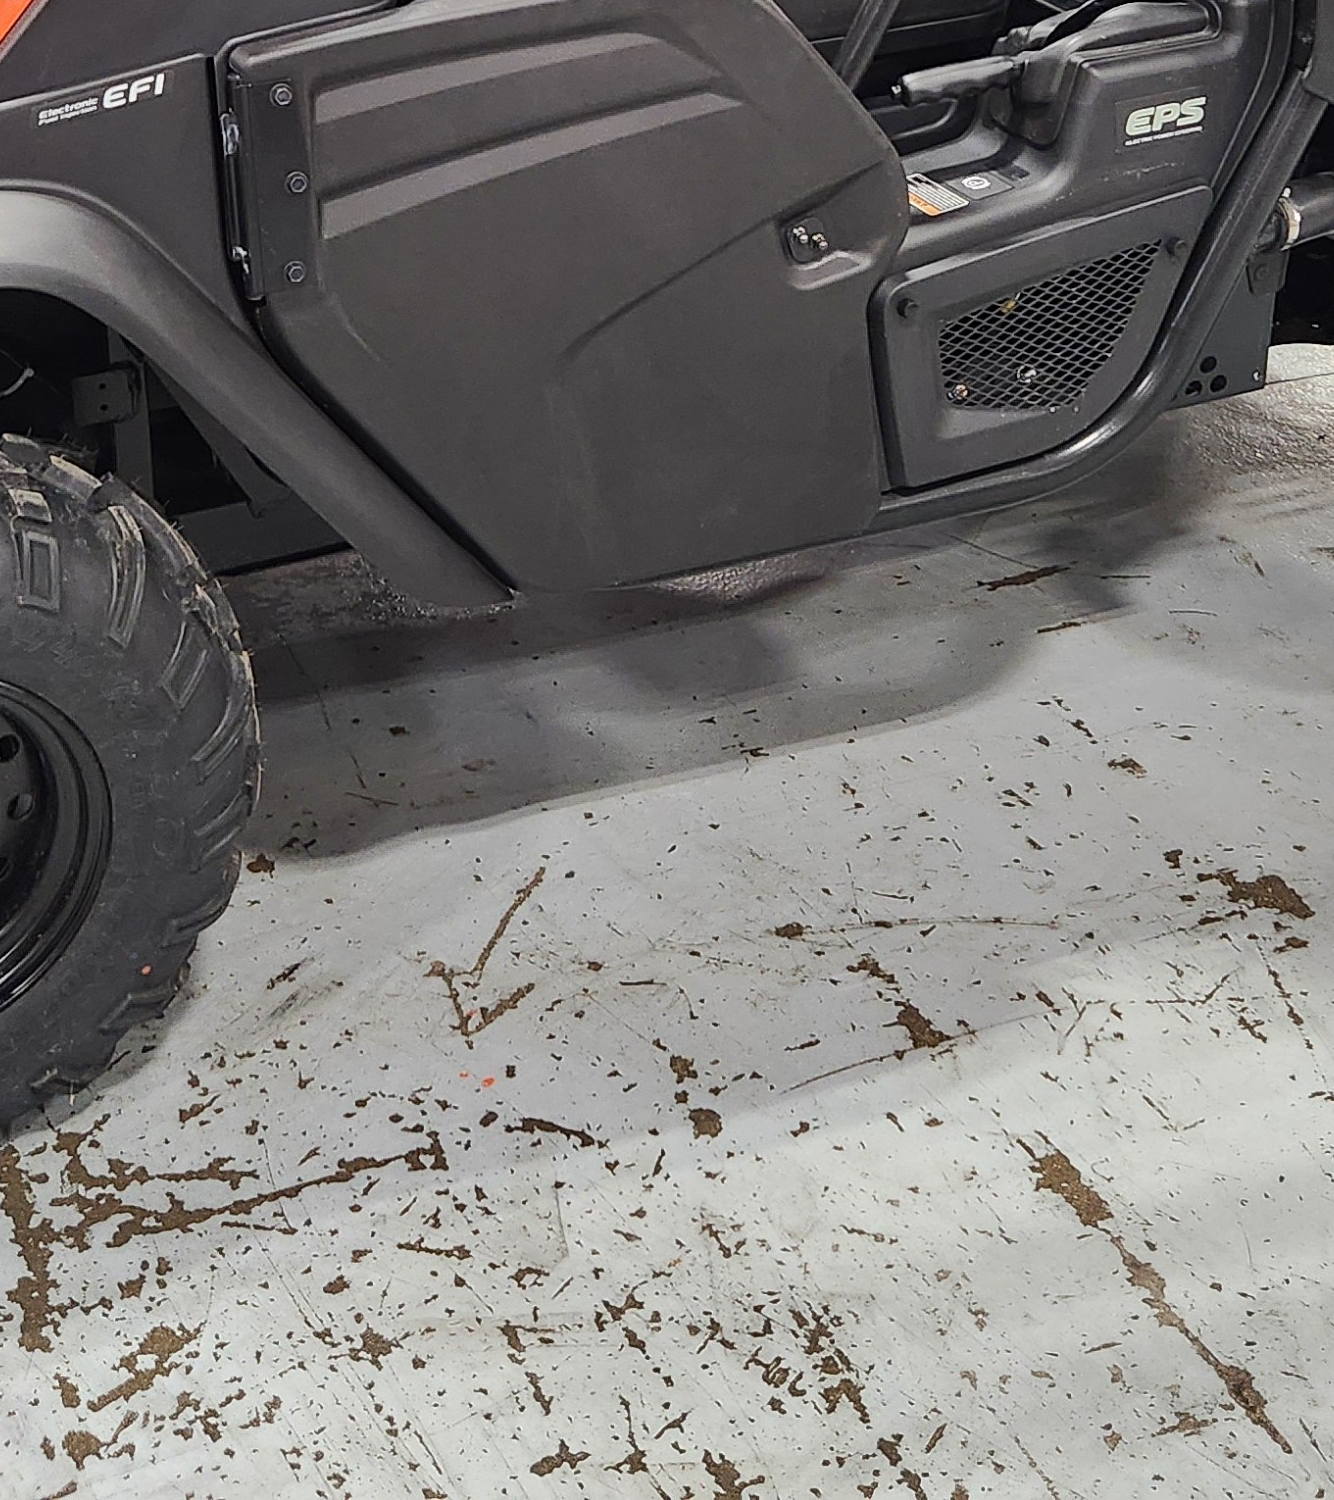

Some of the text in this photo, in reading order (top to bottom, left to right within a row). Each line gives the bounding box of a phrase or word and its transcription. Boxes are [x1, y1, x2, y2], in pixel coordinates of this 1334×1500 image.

[38, 97, 99, 119] Electronic
[102, 73, 165, 109] EFI
[1125, 96, 1207, 136] EPS
